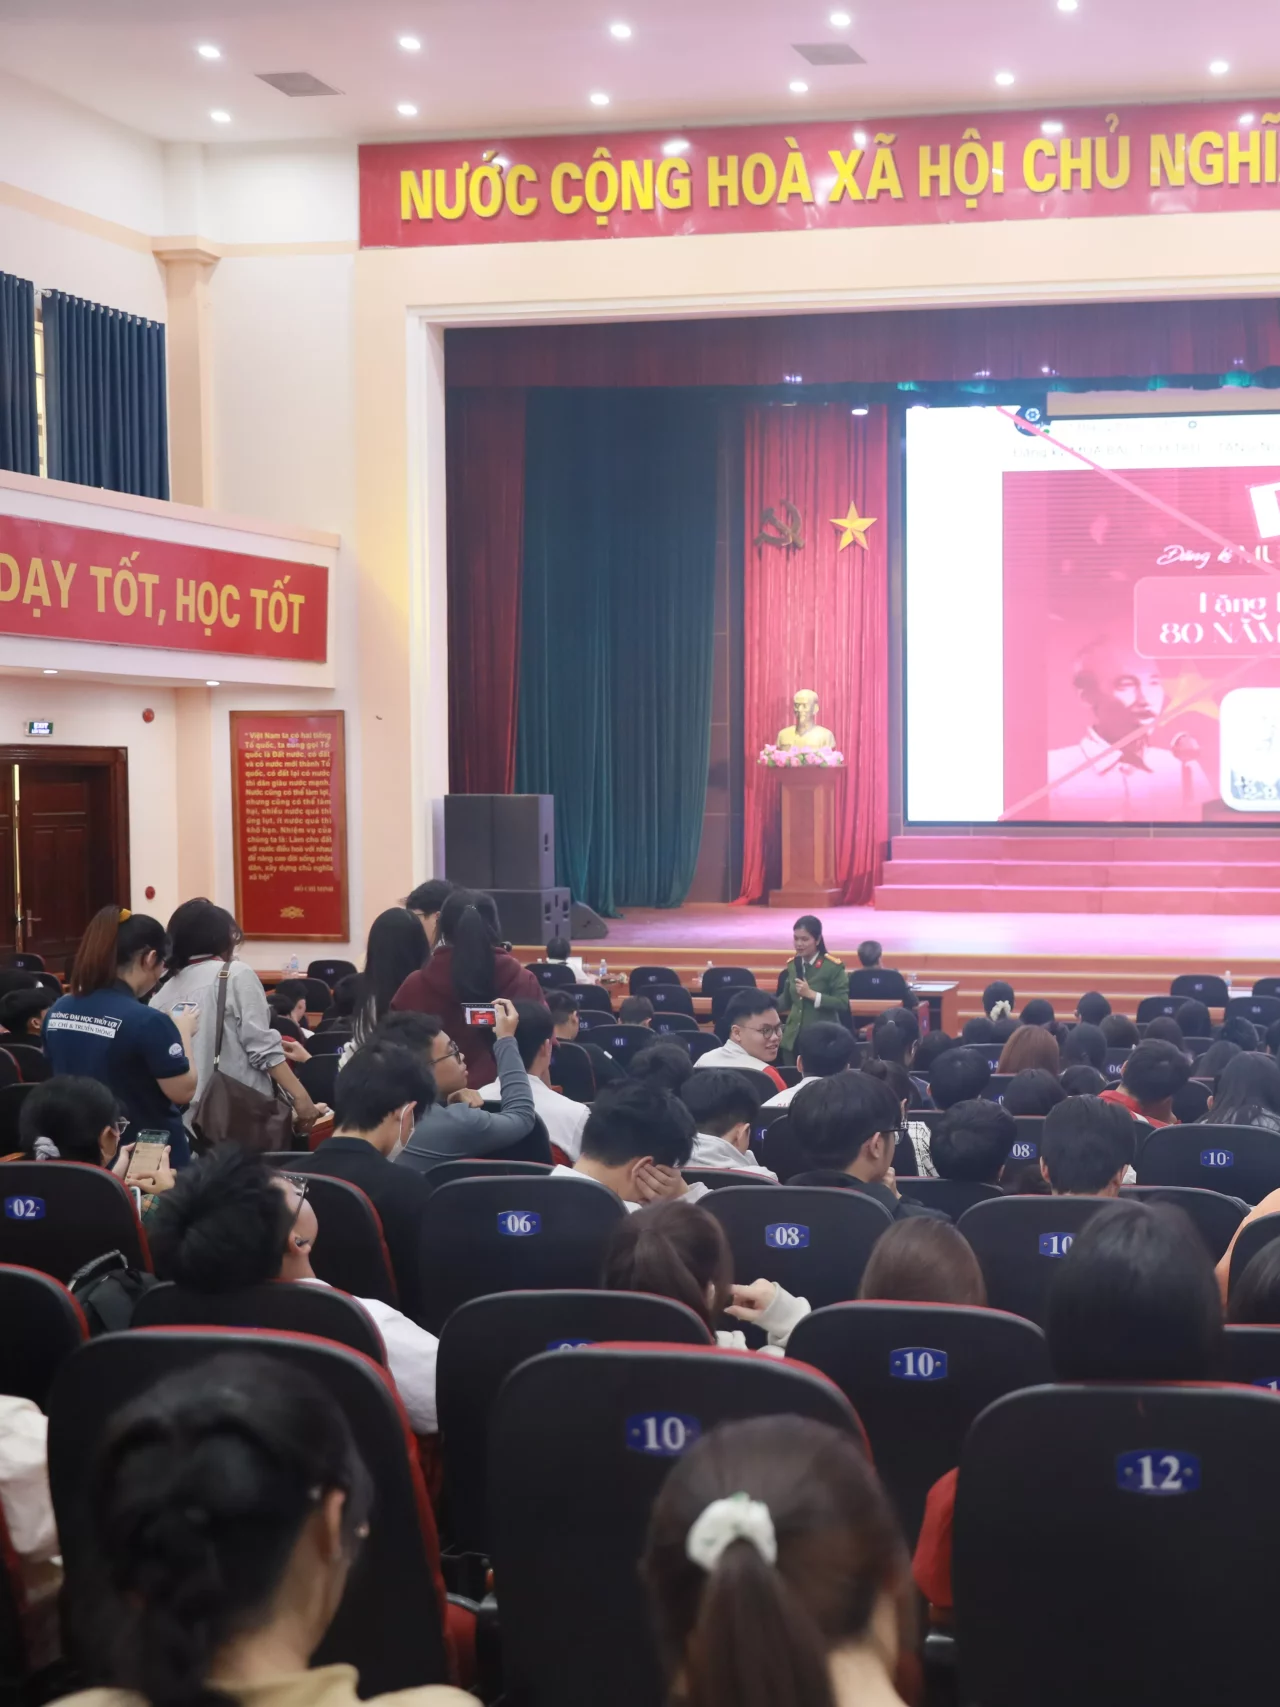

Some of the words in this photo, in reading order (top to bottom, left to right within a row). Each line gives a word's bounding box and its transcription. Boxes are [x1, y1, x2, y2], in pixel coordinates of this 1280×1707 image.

[401, 152, 537, 219] NƯỚC
[551, 148, 690, 224] CỘNG
[708, 138, 812, 206] HOÀ
[829, 134, 901, 201] XÃ
[919, 128, 1005, 201] HỘI
[1023, 114, 1130, 193] CHỦ
[1157, 544, 1210, 569] Đăng
[0, 552, 77, 618] DẠY
[89, 551, 167, 626] TỐT,
[176, 577, 241, 636] HỌC
[250, 574, 305, 635] TỐT
[1160, 622, 1204, 644] 80
[81, 1015, 92, 1023] HỌC
[614, 1038, 623, 1046] 01
[1108, 1064, 1120, 1073] 06
[1012, 1144, 1030, 1157] 08
[1209, 1152, 1226, 1165] 10
[13, 1199, 37, 1217] 02
[506, 1213, 530, 1233] 06
[775, 1225, 799, 1246] 08
[1049, 1234, 1073, 1255] 10
[903, 1352, 935, 1378] 10
[643, 1416, 684, 1450] 10
[1137, 1455, 1183, 1489] 12
